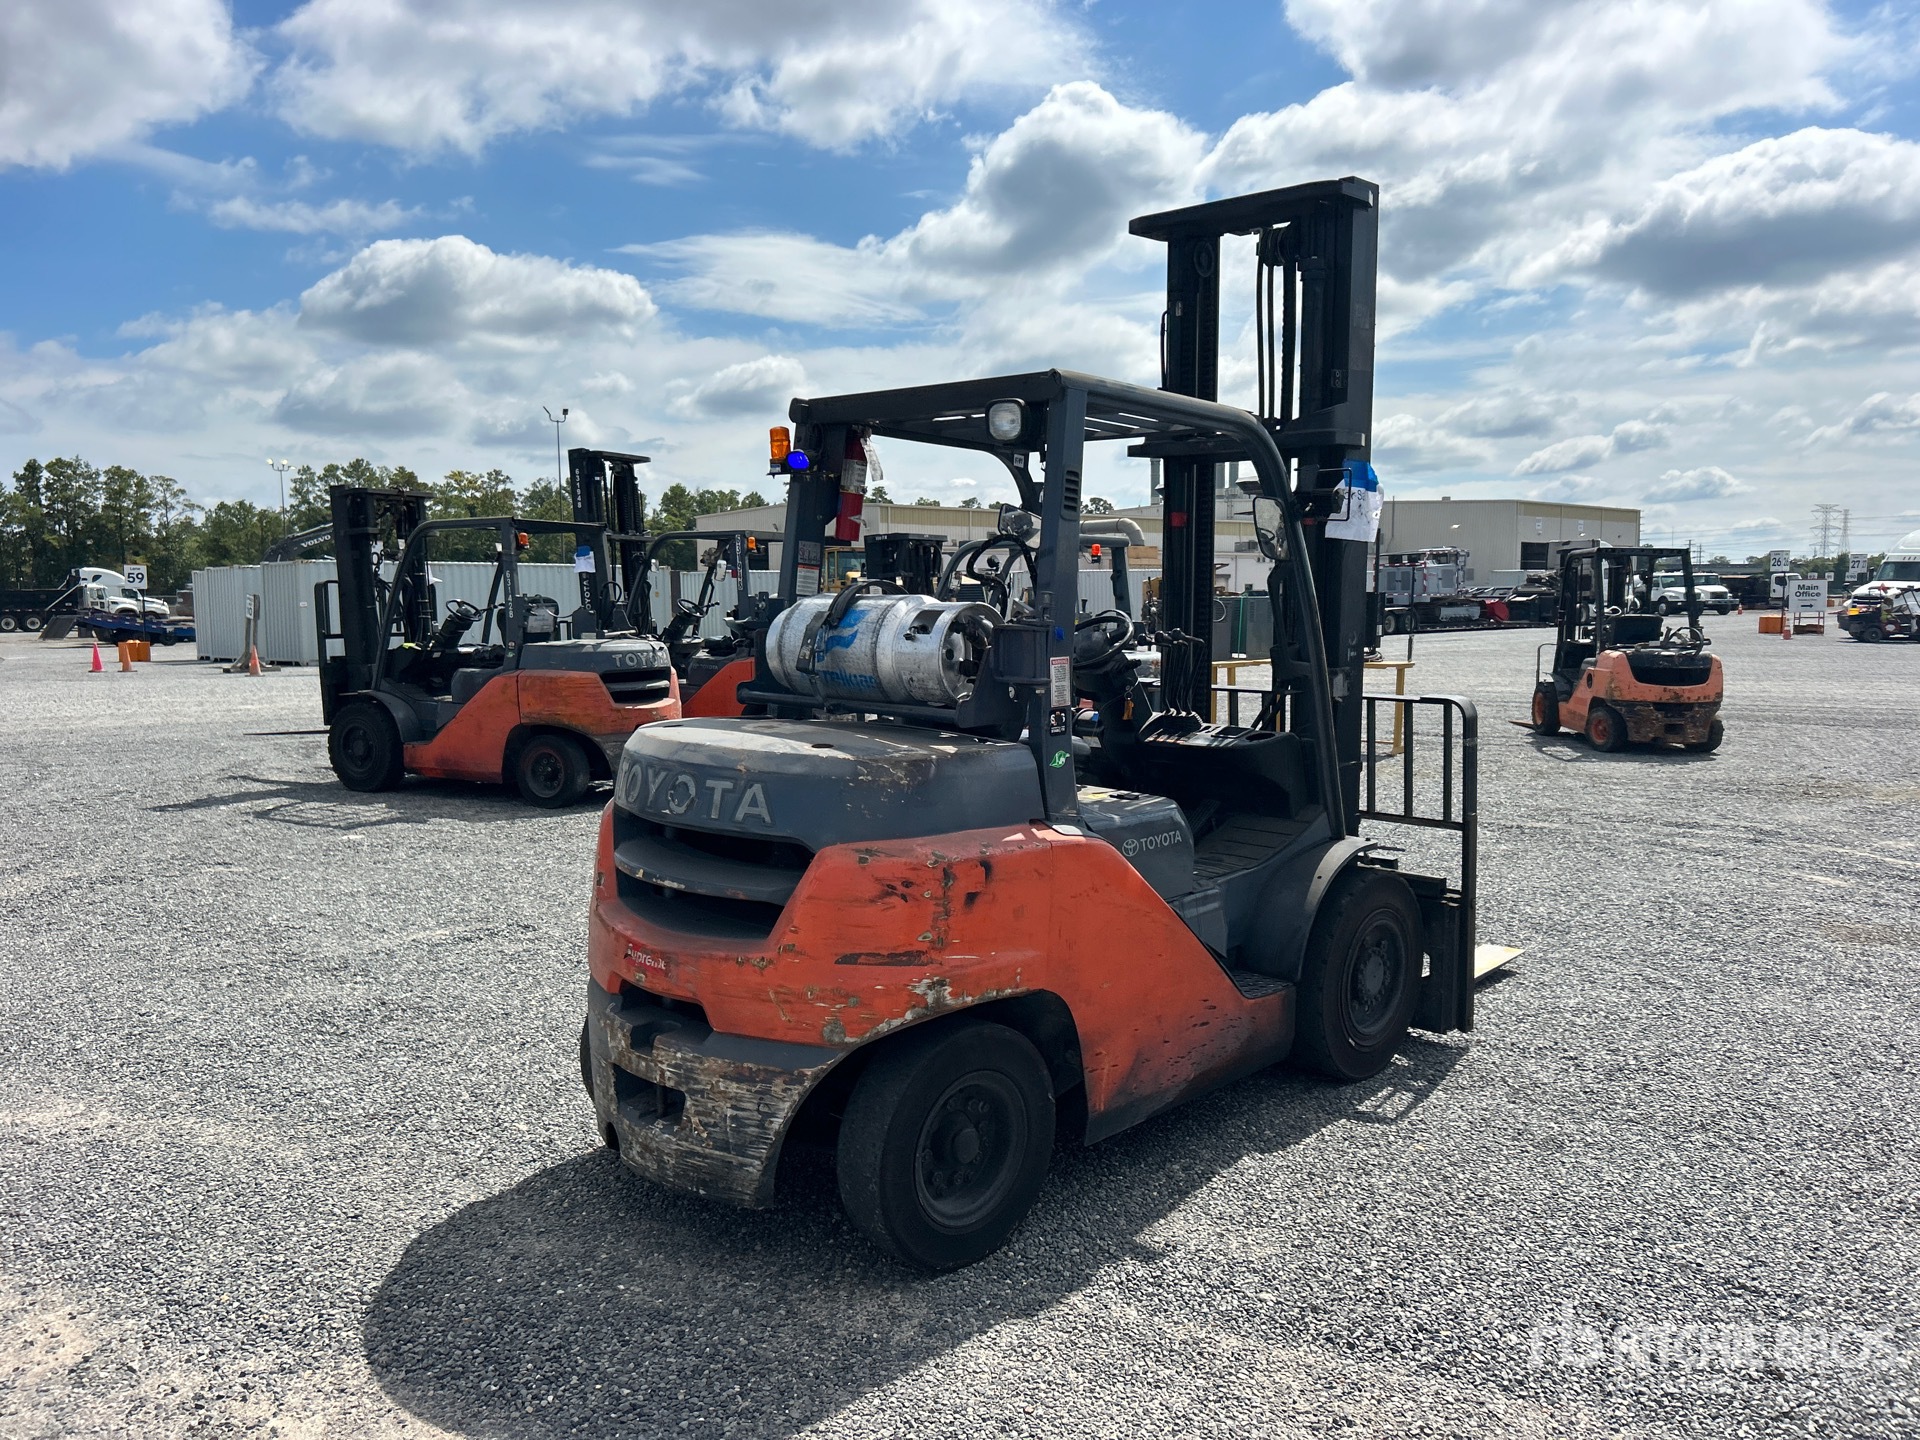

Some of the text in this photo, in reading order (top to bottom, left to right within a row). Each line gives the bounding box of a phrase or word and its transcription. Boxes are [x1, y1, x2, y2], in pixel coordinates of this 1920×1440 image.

[301, 534, 331, 548] VOLVO
[1771, 557, 1782, 567] 26
[1850, 560, 1861, 569] 27
[127, 572, 145, 584] 59
[583, 580, 592, 610] OYOTA
[615, 756, 773, 825] TOYOTA
[1141, 830, 1182, 851] TOYOTA
